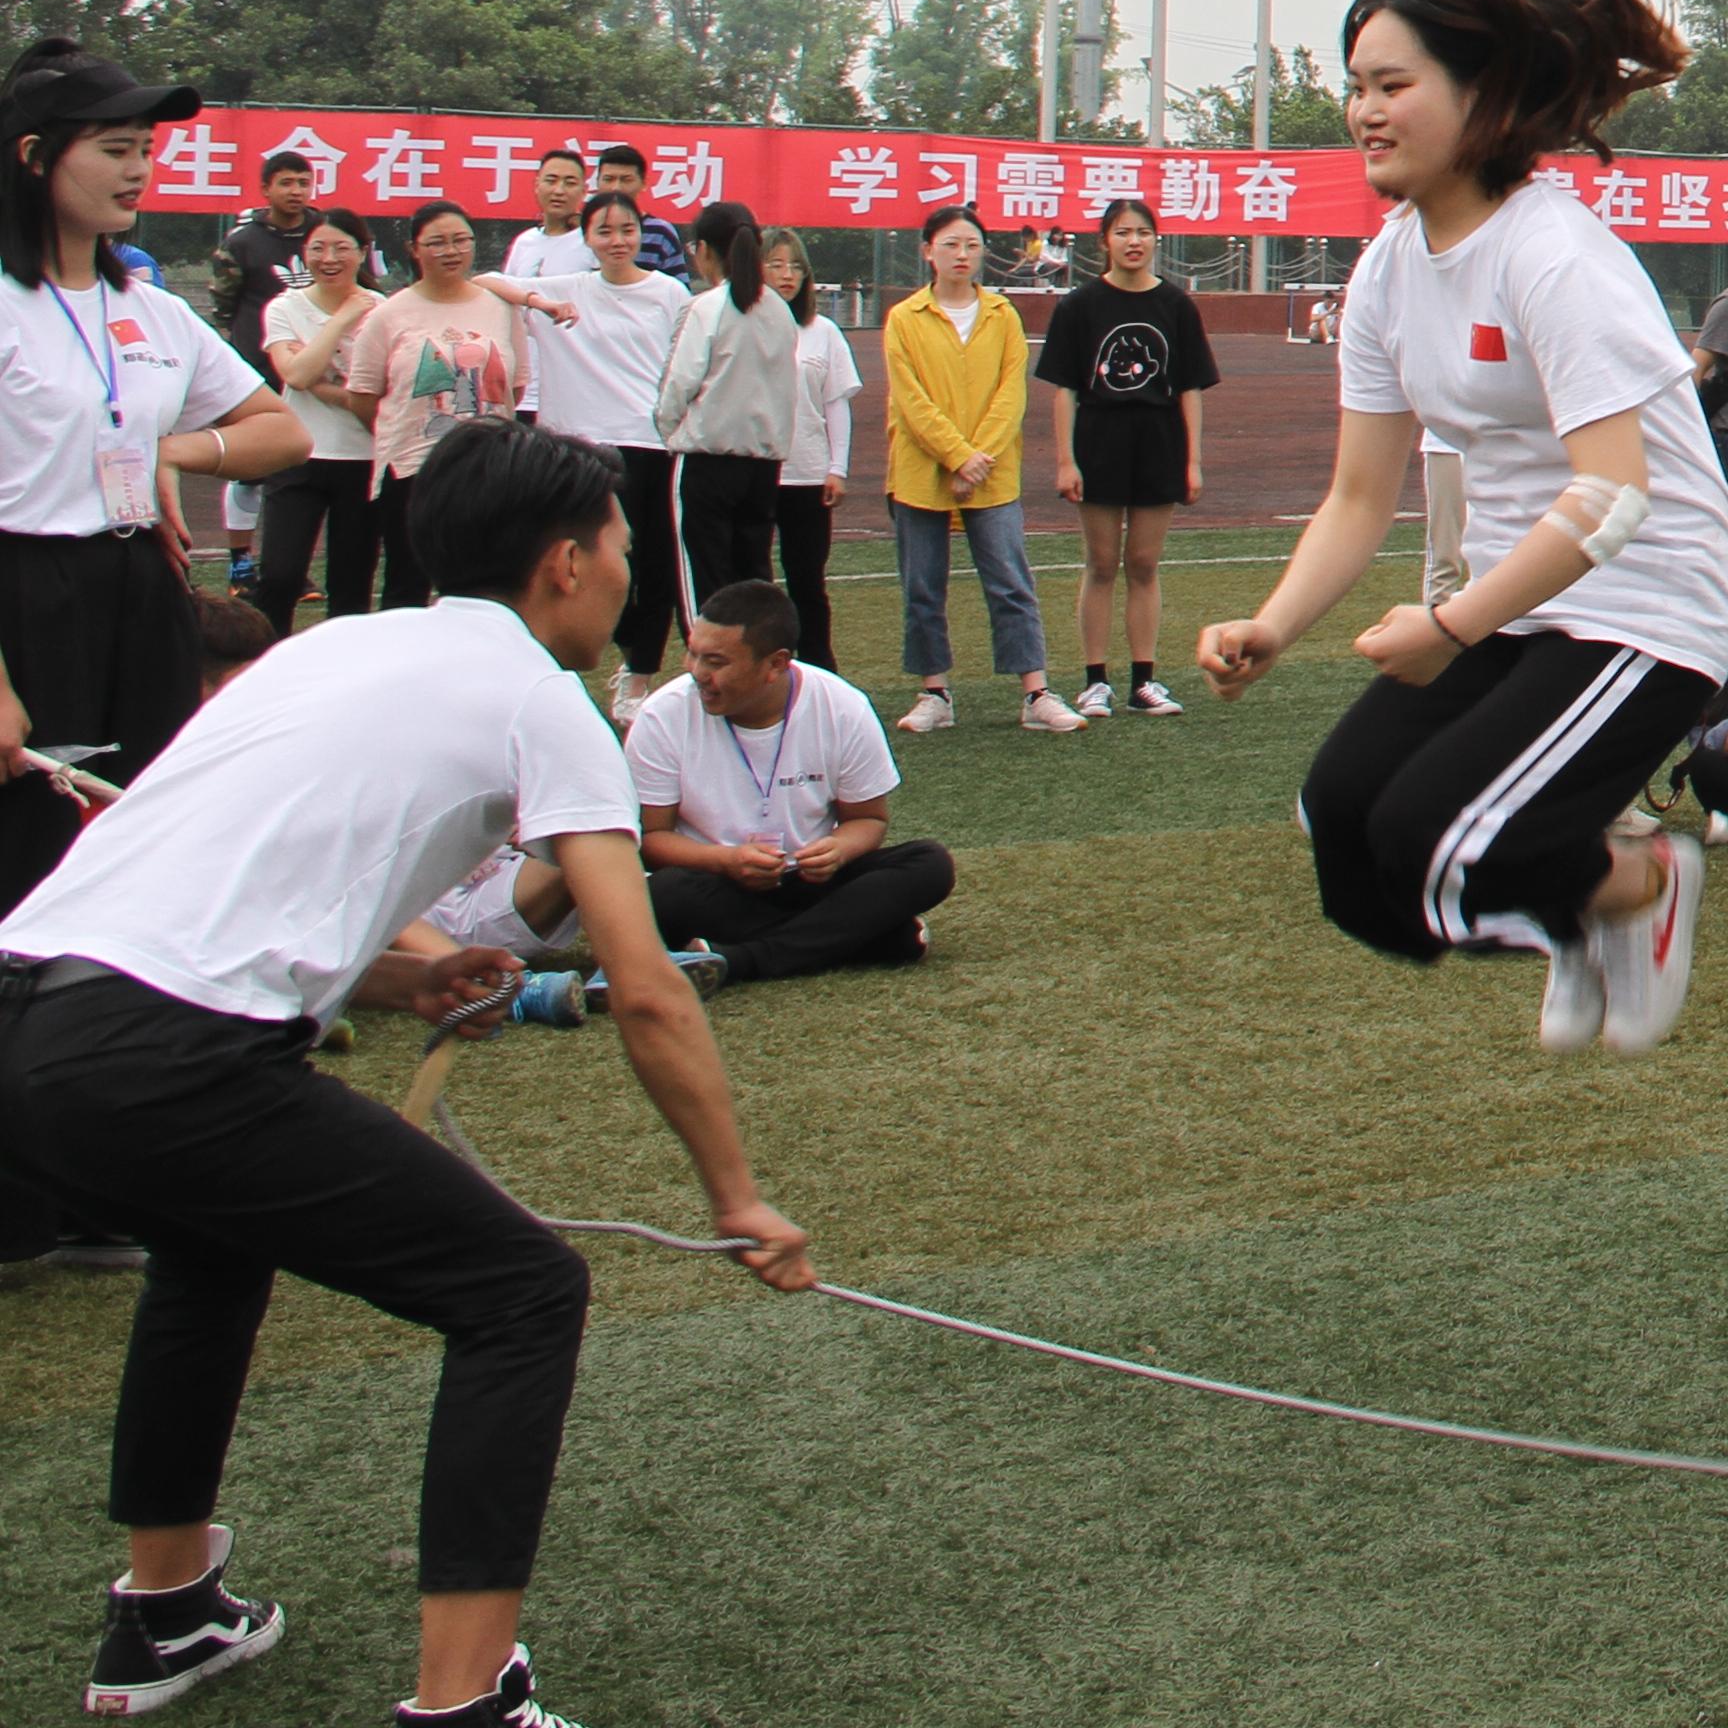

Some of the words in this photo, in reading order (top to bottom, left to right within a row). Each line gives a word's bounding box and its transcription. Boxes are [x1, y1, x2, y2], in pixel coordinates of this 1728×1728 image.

[828, 145, 1299, 223] 学习需要勤奋
